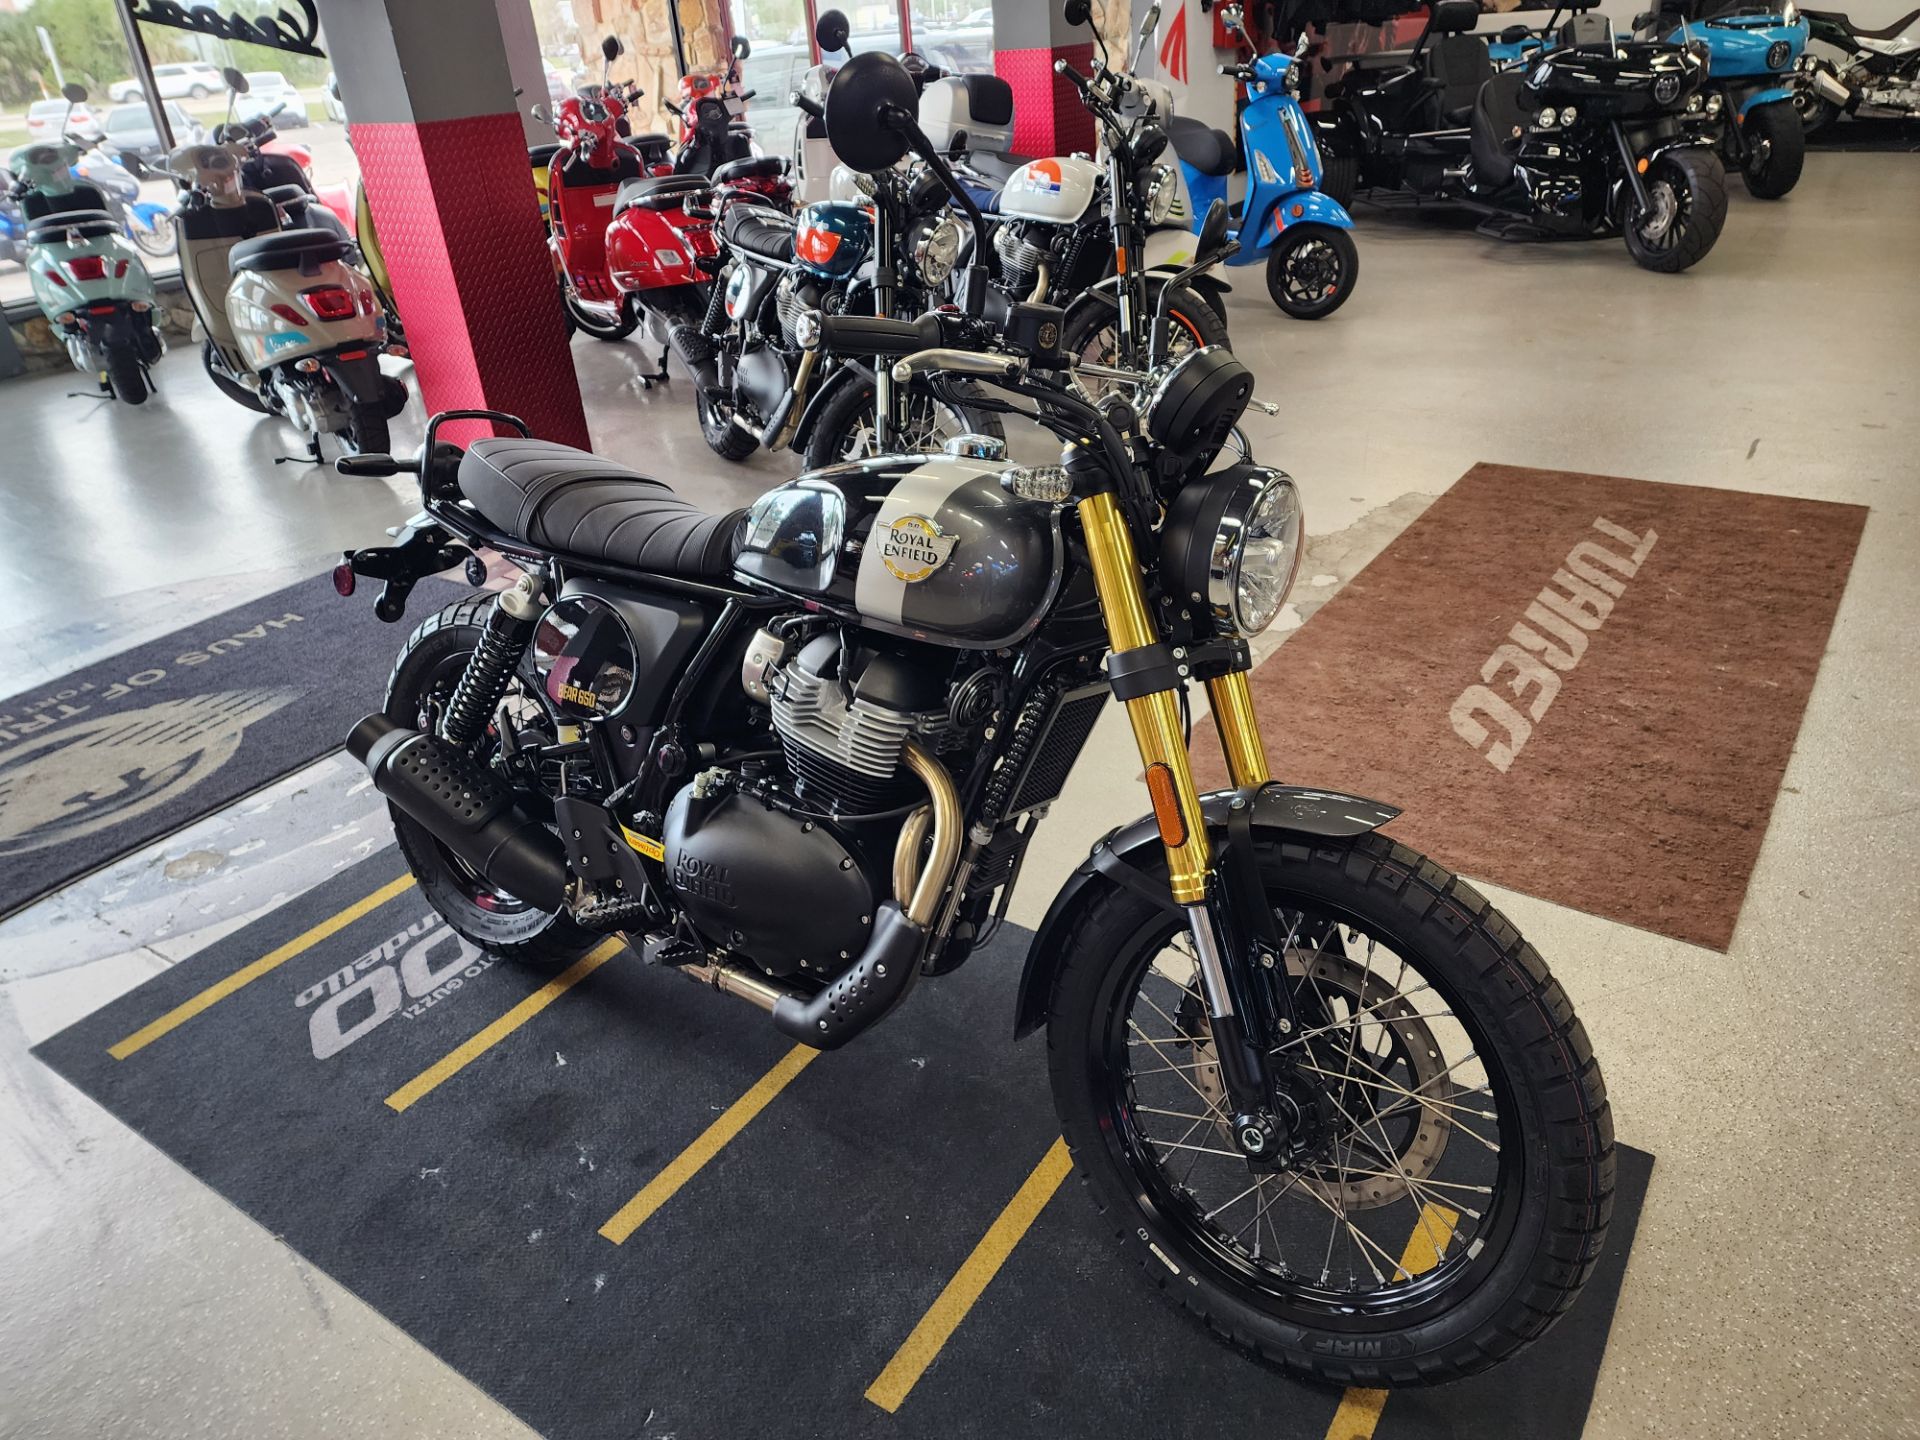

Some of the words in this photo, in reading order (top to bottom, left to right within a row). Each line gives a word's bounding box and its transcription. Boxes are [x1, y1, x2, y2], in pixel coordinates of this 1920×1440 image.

[884, 543, 939, 566] ENFIELD
[890, 528, 934, 549] ROYAL
[175, 612, 305, 666] HAUS
[1449, 516, 1659, 774] TUAREG
[101, 668, 167, 700] OF
[558, 682, 578, 703] BEAR
[577, 689, 596, 709] 650
[0, 702, 91, 747] TRI
[676, 847, 731, 887] ROYAL
[294, 911, 444, 1008] ndello
[401, 977, 464, 1020] GUZZI
[1312, 1339, 1381, 1358] MRF
